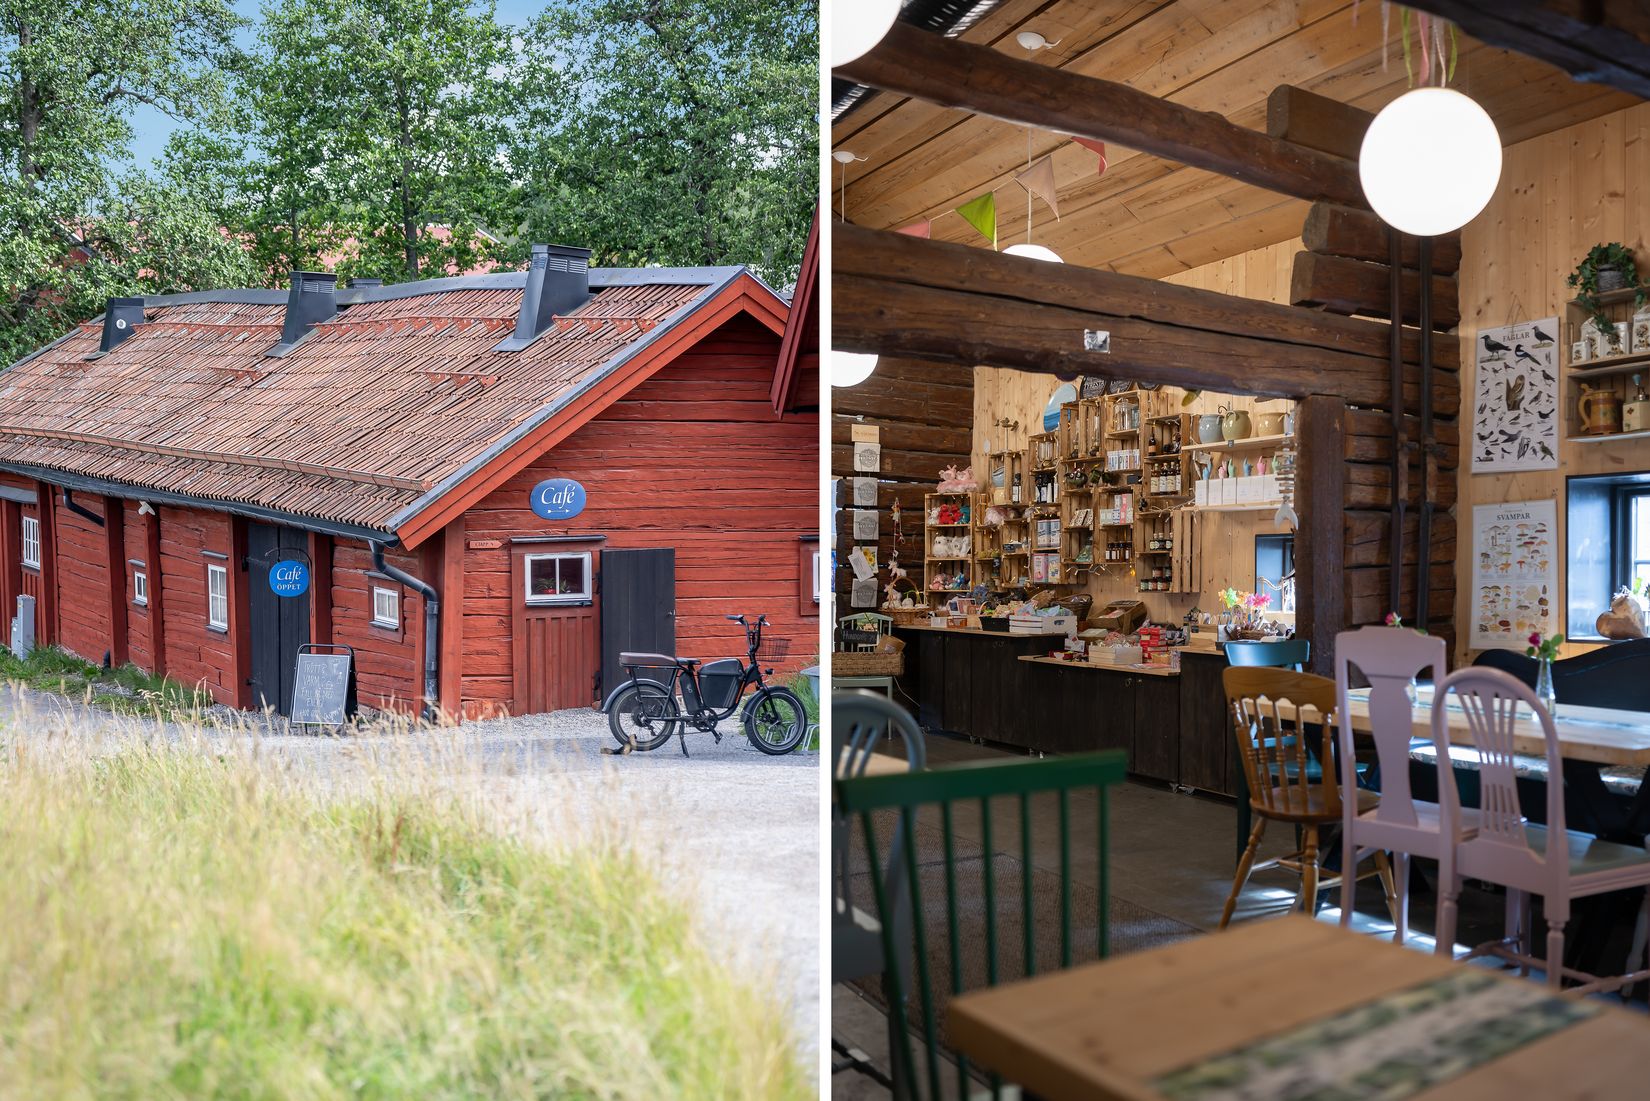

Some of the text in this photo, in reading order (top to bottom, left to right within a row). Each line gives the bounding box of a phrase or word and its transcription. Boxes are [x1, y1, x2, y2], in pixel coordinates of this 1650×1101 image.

[541, 484, 576, 509] Café
[1496, 512, 1530, 521] SVAMPAR
[276, 565, 302, 584] Café
[276, 582, 301, 591] ÖPPET
